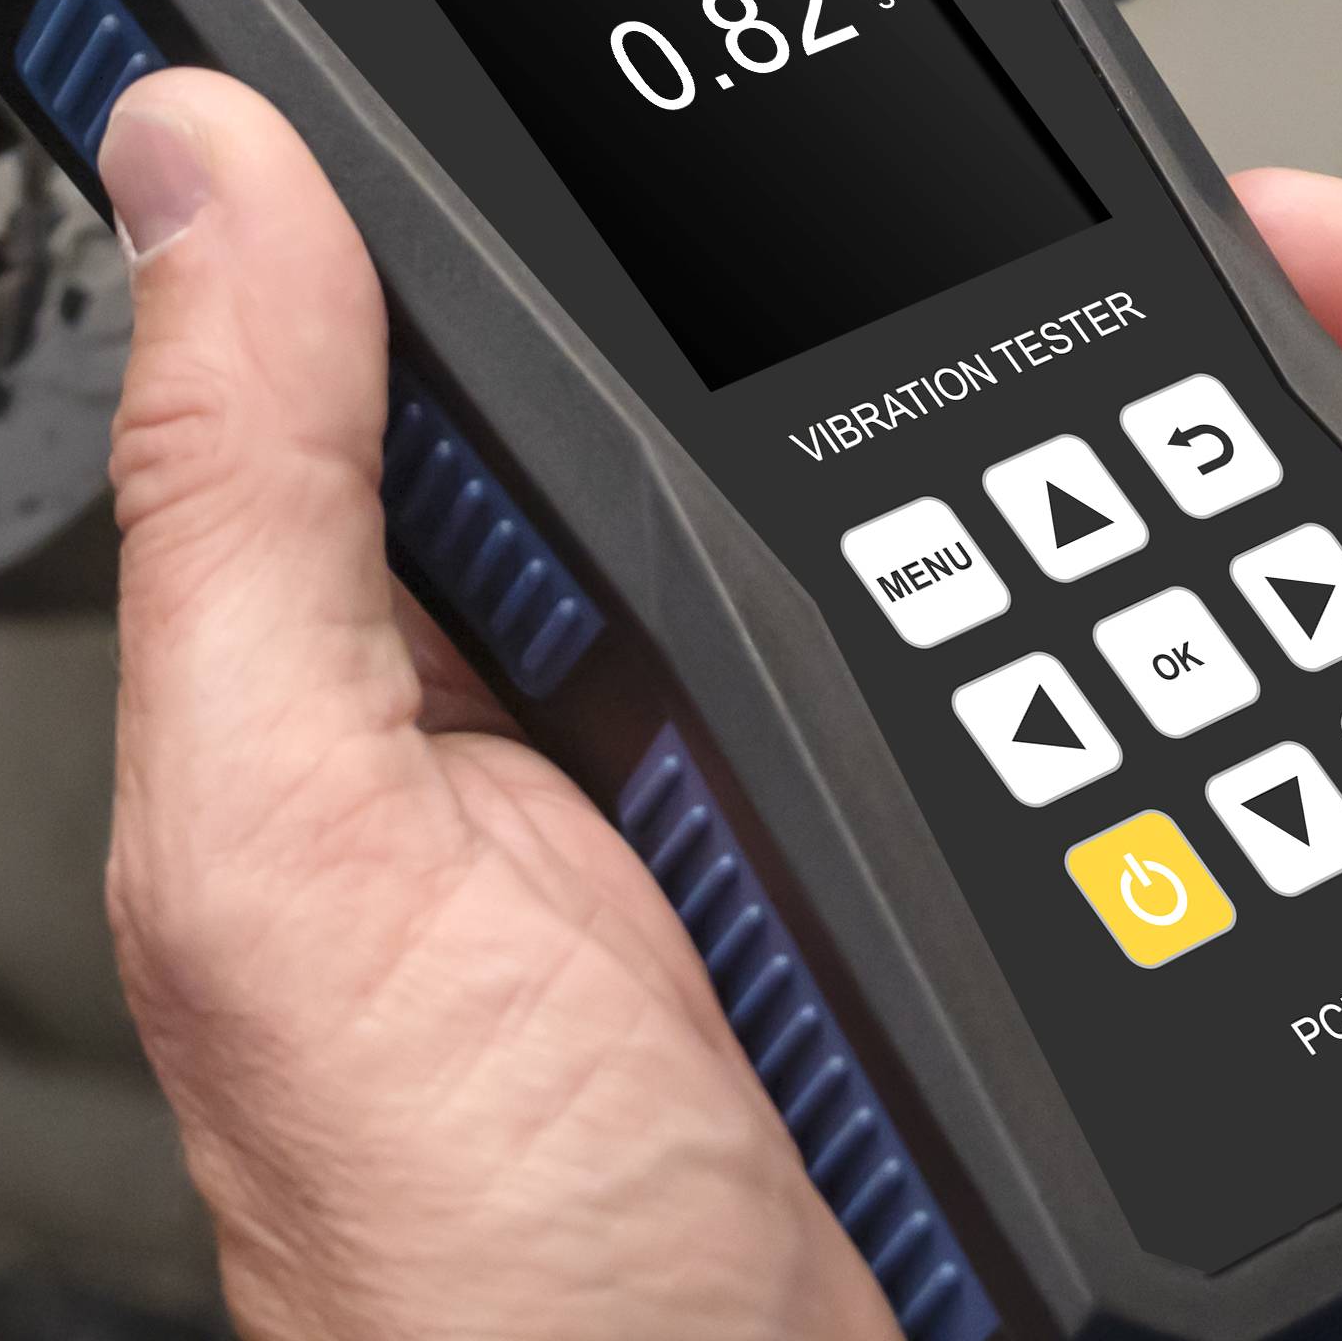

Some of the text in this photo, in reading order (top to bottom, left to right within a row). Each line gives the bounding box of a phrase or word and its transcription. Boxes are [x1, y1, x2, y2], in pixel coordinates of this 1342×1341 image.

[788, 291, 1147, 464] VIBRATION TESTER
[875, 540, 973, 604] MENU
[1151, 639, 1206, 682] OK
